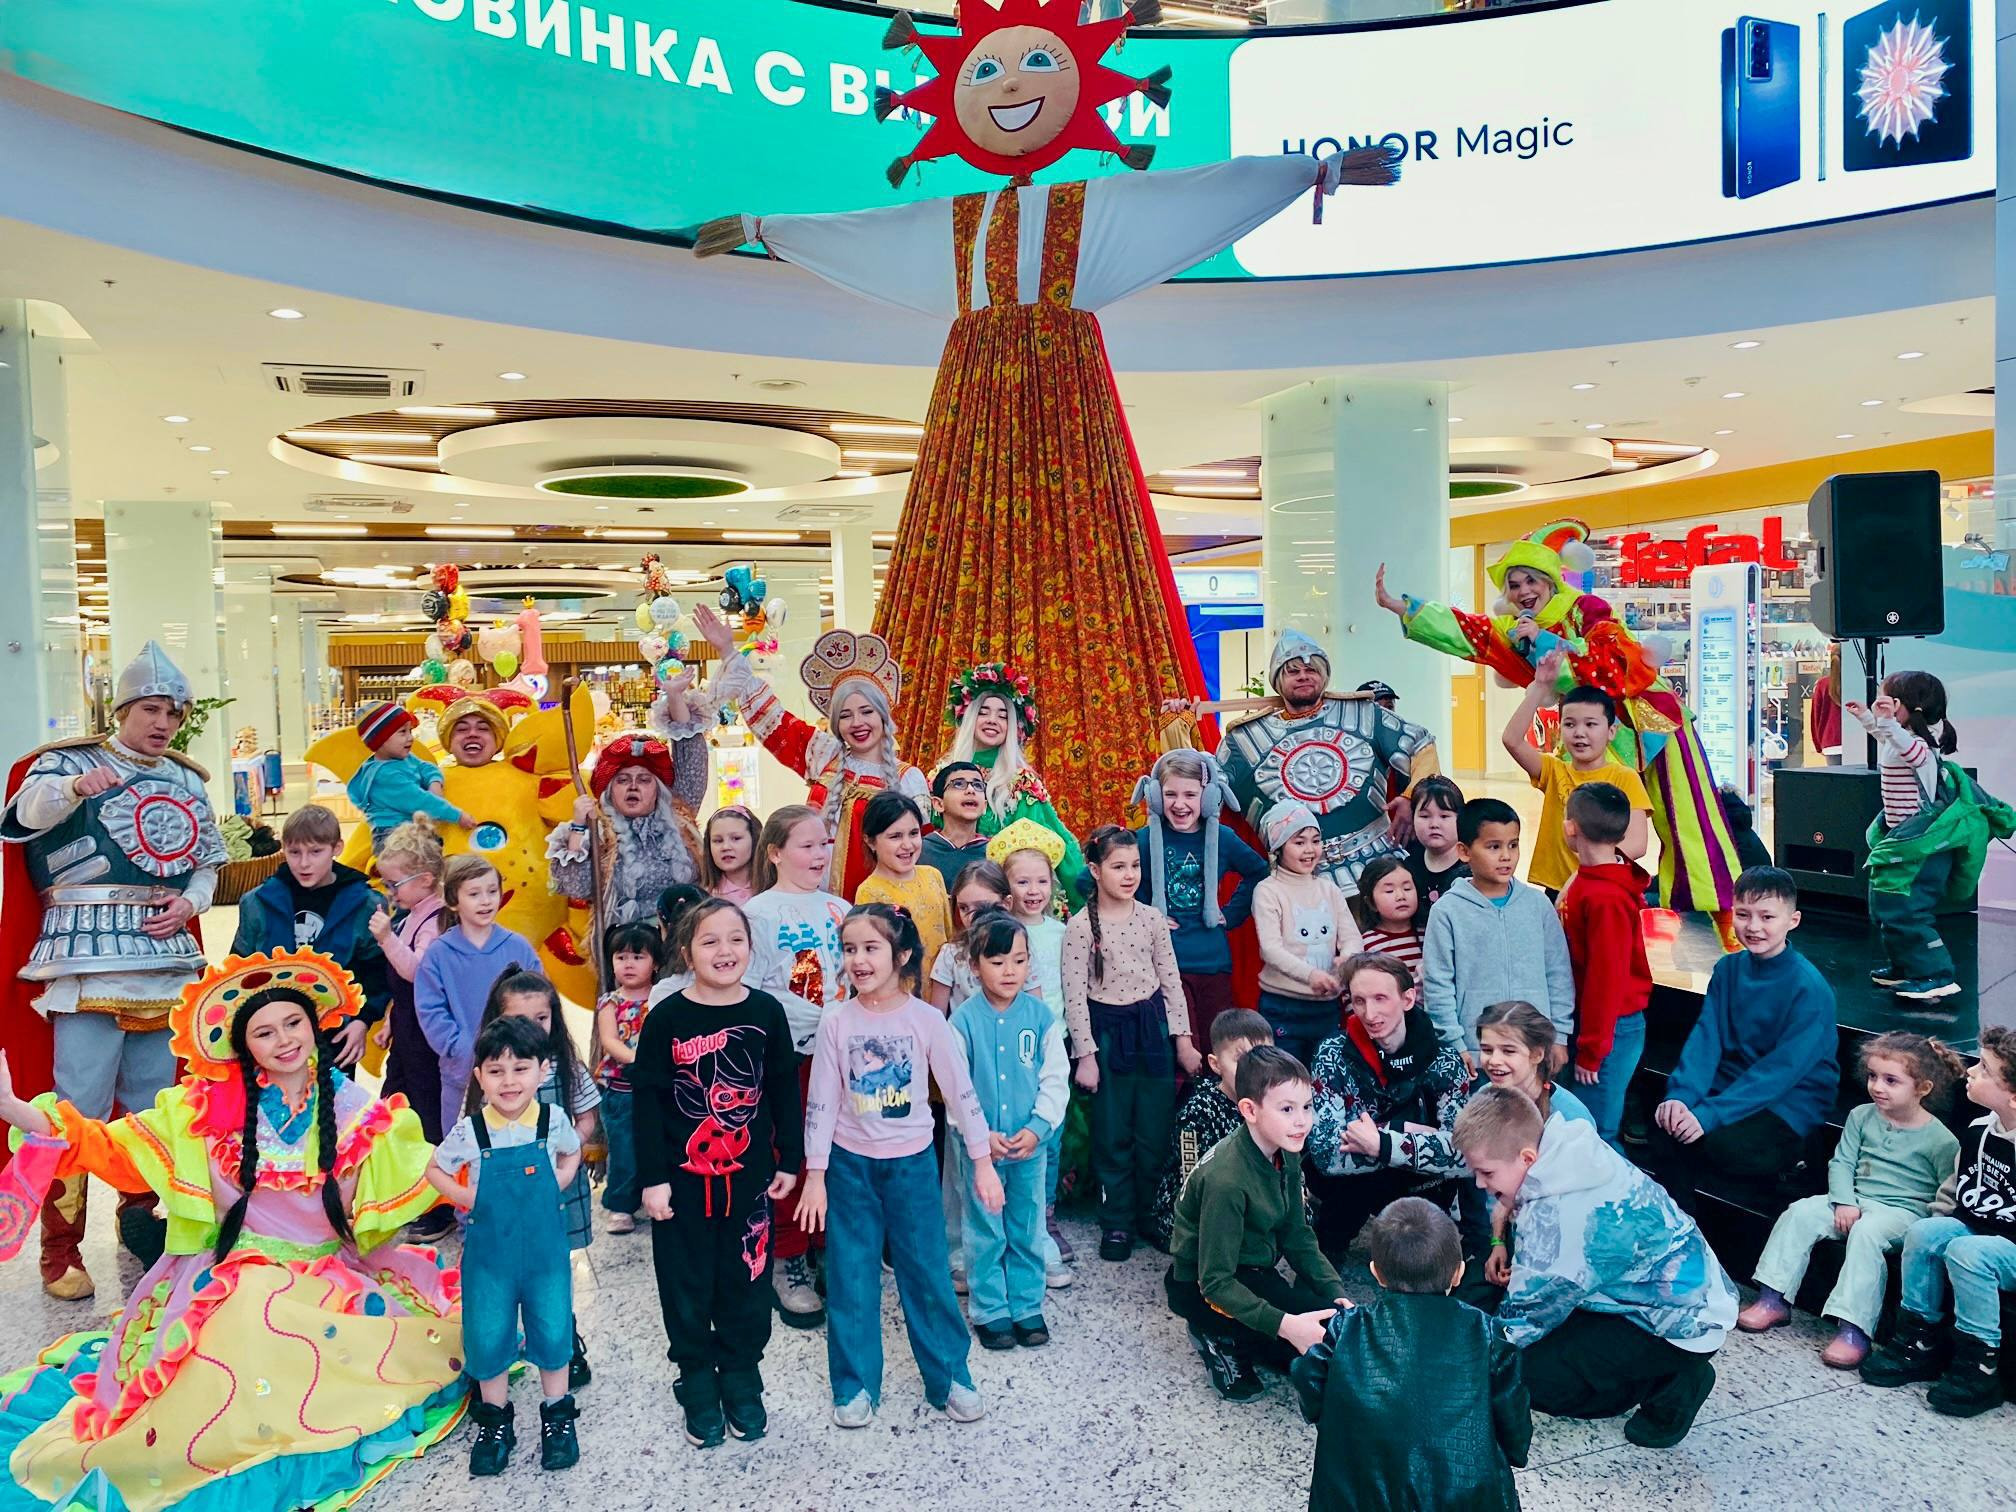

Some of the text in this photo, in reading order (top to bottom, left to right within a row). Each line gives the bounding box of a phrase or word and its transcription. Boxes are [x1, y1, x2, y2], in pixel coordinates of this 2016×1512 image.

[388, 0, 734, 95] ВИНКА
[754, 51, 807, 107] С
[1456, 116, 1574, 160] Magic
[673, 1031, 727, 1064] LADYBUG
